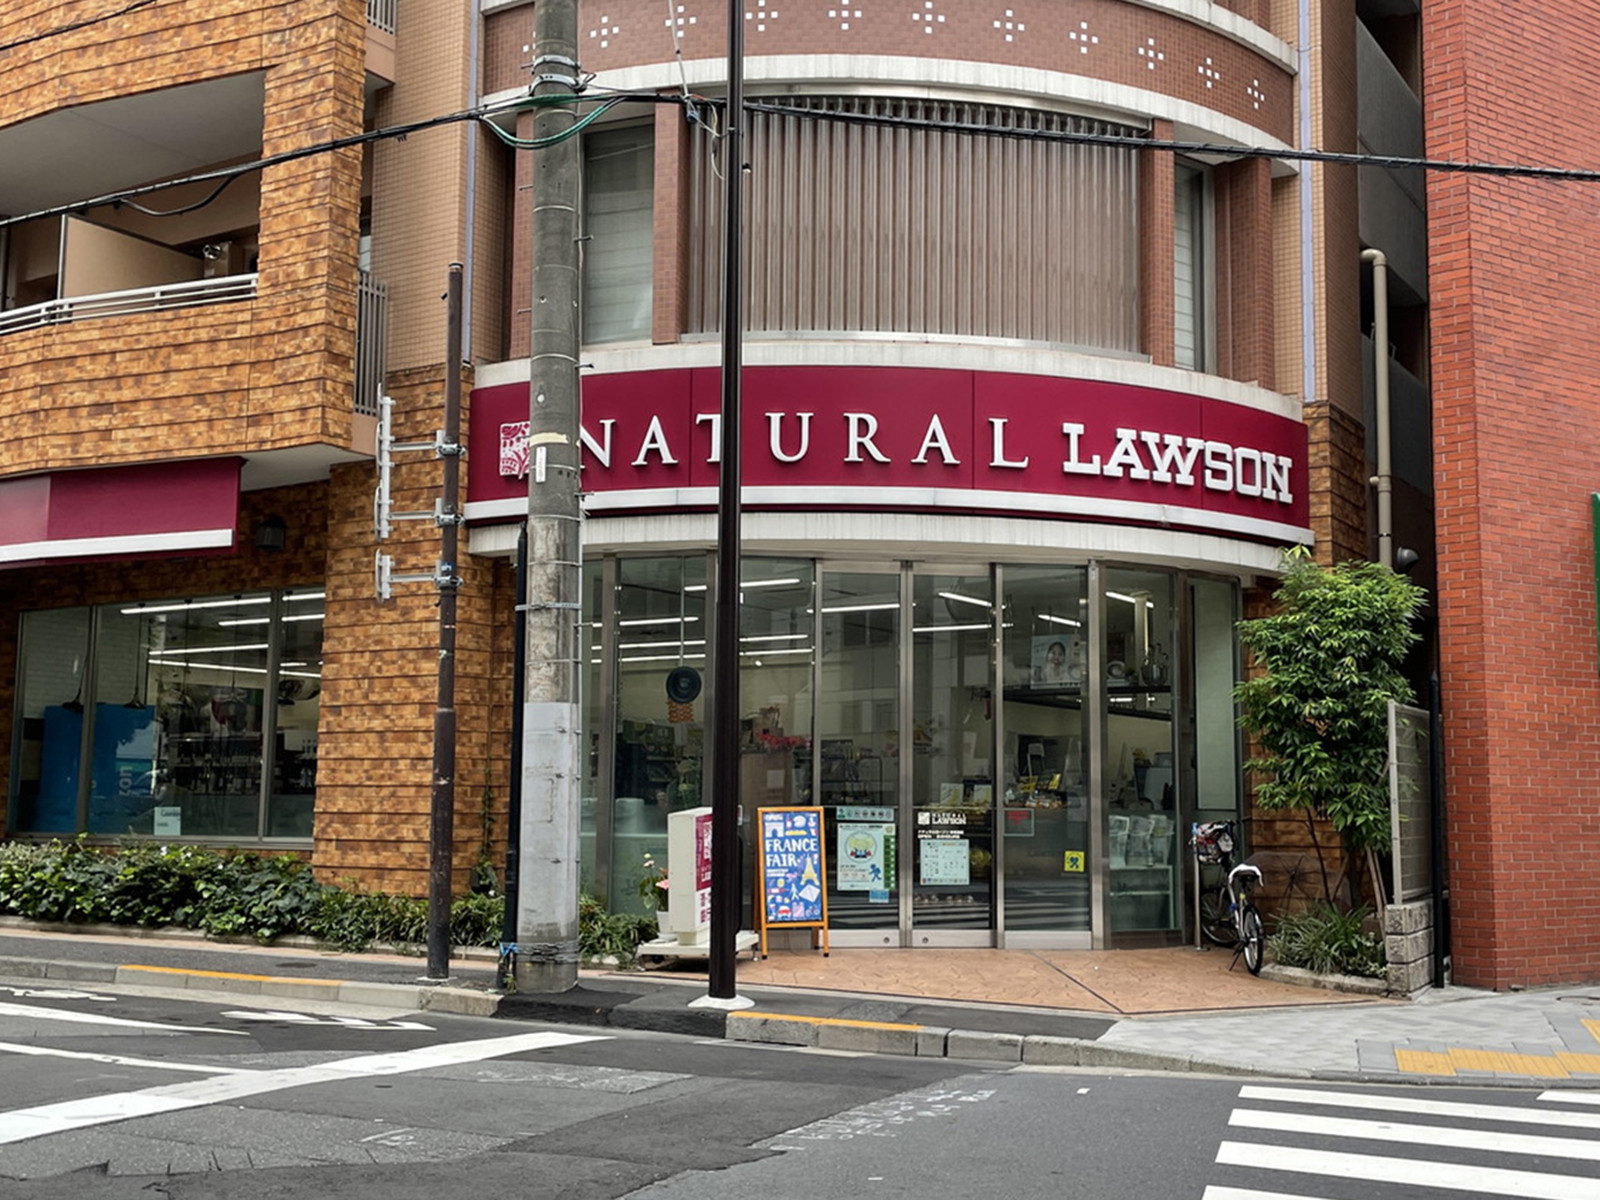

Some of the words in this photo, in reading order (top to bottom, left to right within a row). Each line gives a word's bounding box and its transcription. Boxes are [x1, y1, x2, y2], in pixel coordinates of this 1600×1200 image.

[580, 412, 1029, 468] NATURAL
[1062, 422, 1293, 504] LAWSON
[765, 838, 818, 852] FRANCE
[766, 853, 798, 867] FAIR
